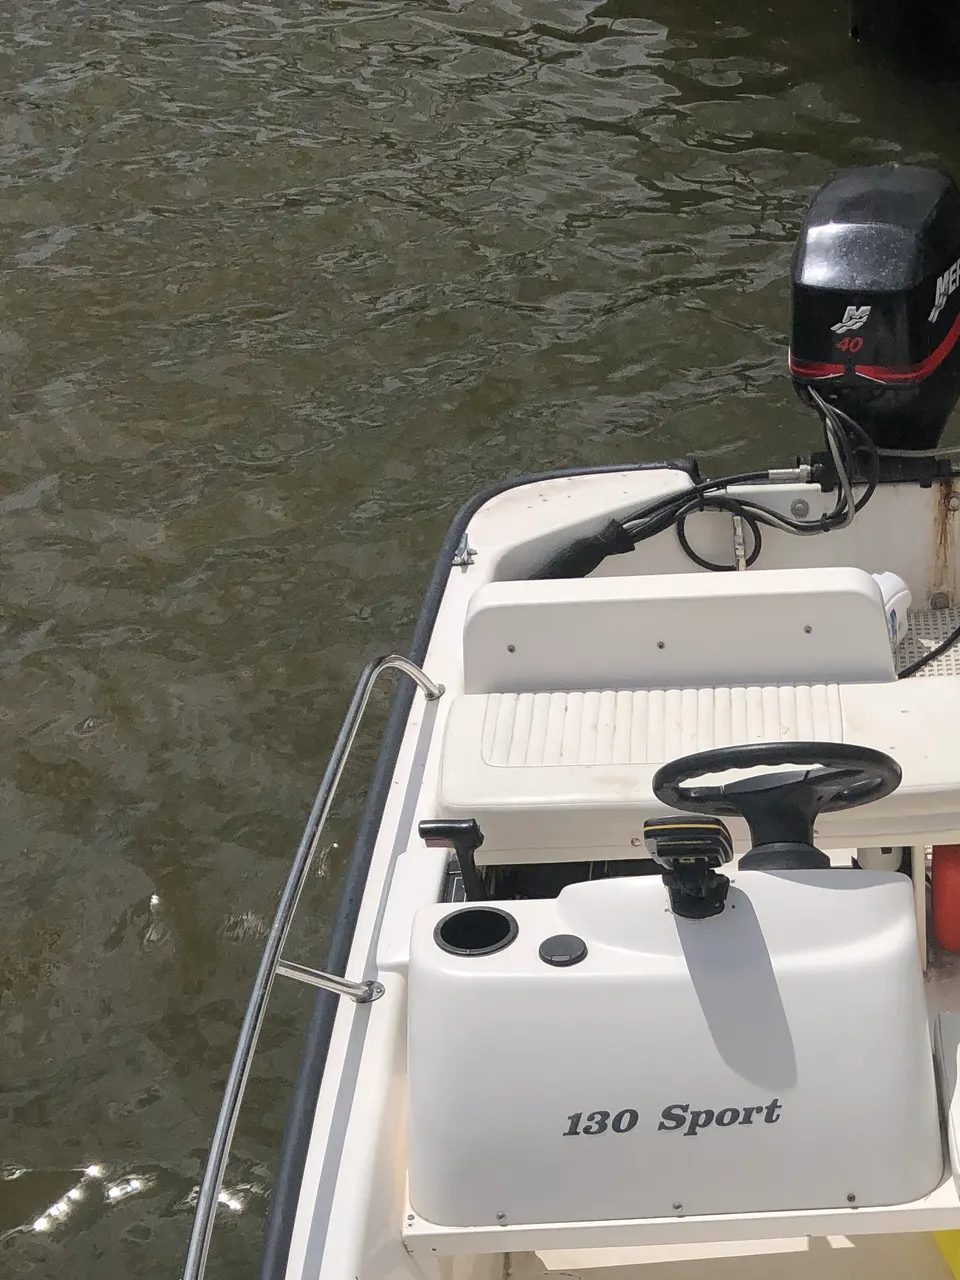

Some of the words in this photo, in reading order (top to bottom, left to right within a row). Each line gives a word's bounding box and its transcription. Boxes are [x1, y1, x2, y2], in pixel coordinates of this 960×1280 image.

[835, 336, 864, 353] 40
[563, 1109, 639, 1136] 130
[657, 1098, 783, 1137] Sport
